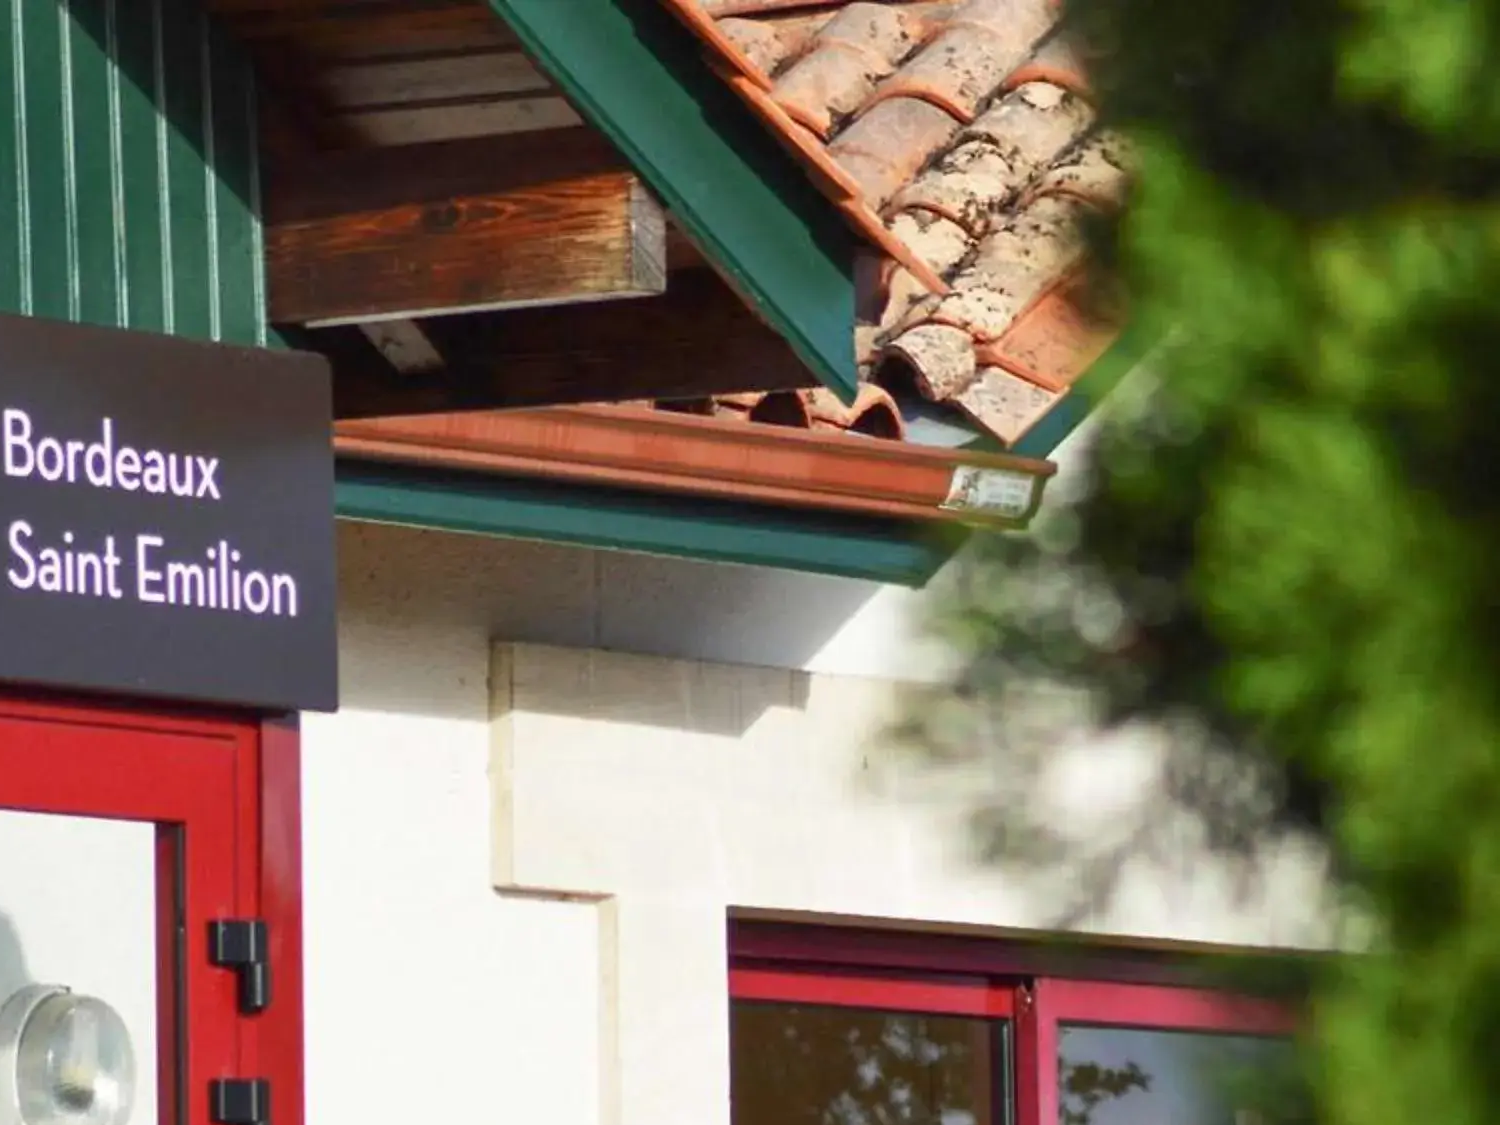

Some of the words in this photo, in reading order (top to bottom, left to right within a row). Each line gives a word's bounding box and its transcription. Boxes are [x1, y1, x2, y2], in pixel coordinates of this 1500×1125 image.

[2, 407, 222, 501] Bordeaux
[6, 519, 124, 600] Saint
[135, 533, 298, 619] Emilion
